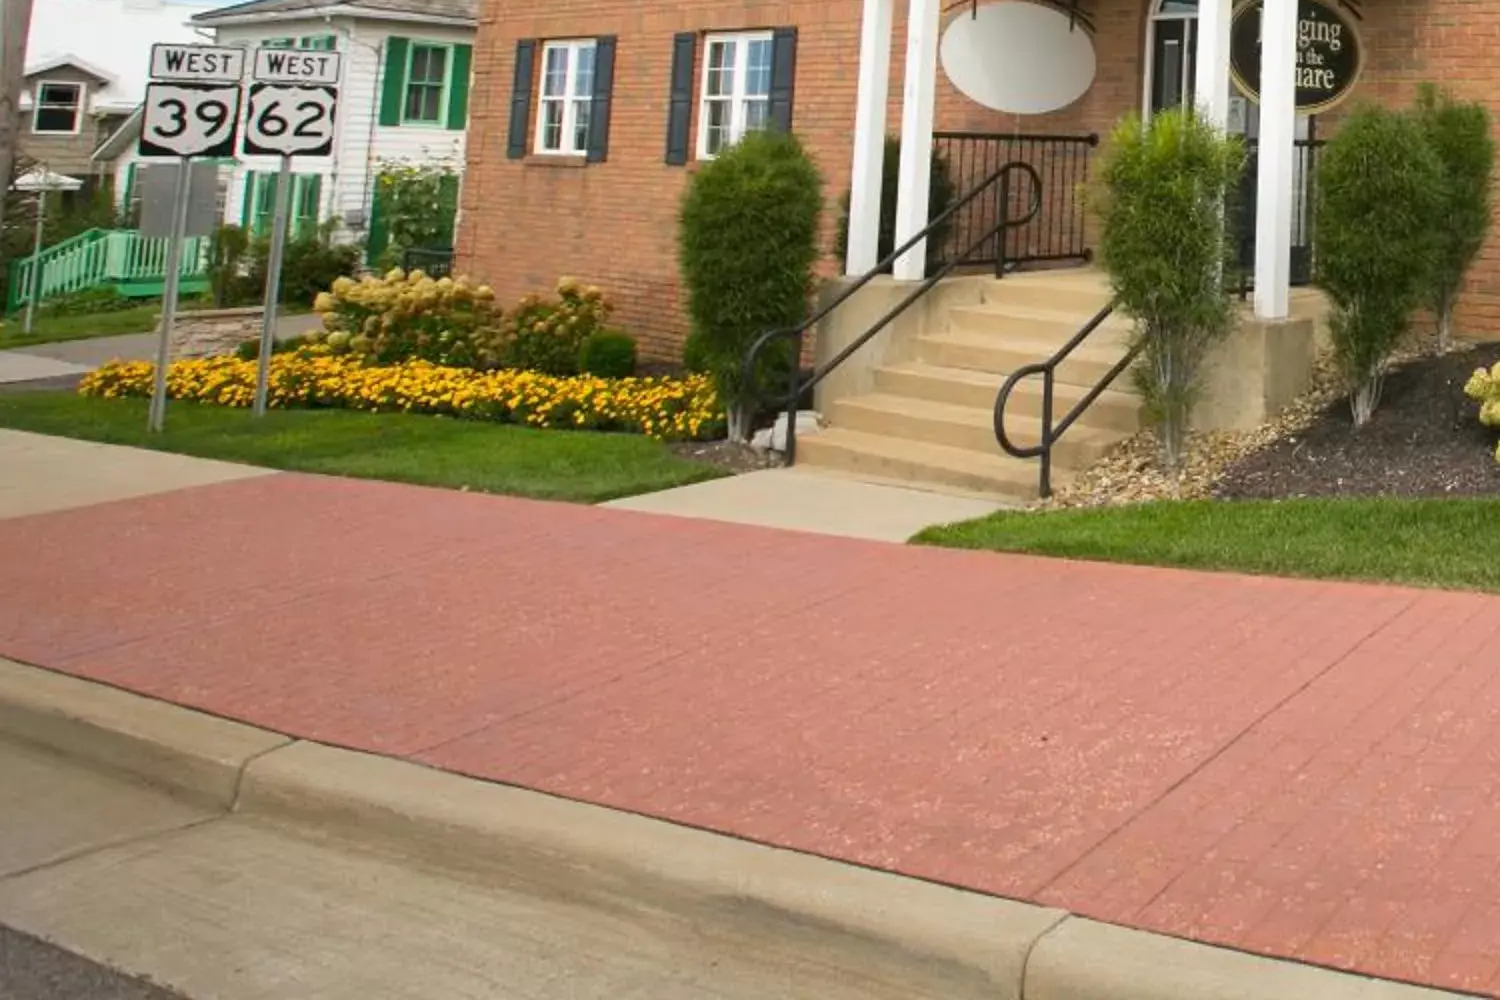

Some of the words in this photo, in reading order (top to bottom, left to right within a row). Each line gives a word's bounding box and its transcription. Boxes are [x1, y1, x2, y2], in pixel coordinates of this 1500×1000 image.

[166, 50, 232, 73] WEST
[268, 53, 329, 76] WEST
[1305, 47, 1324, 65] the
[153, 99, 229, 138] 39
[257, 101, 326, 137] 62
